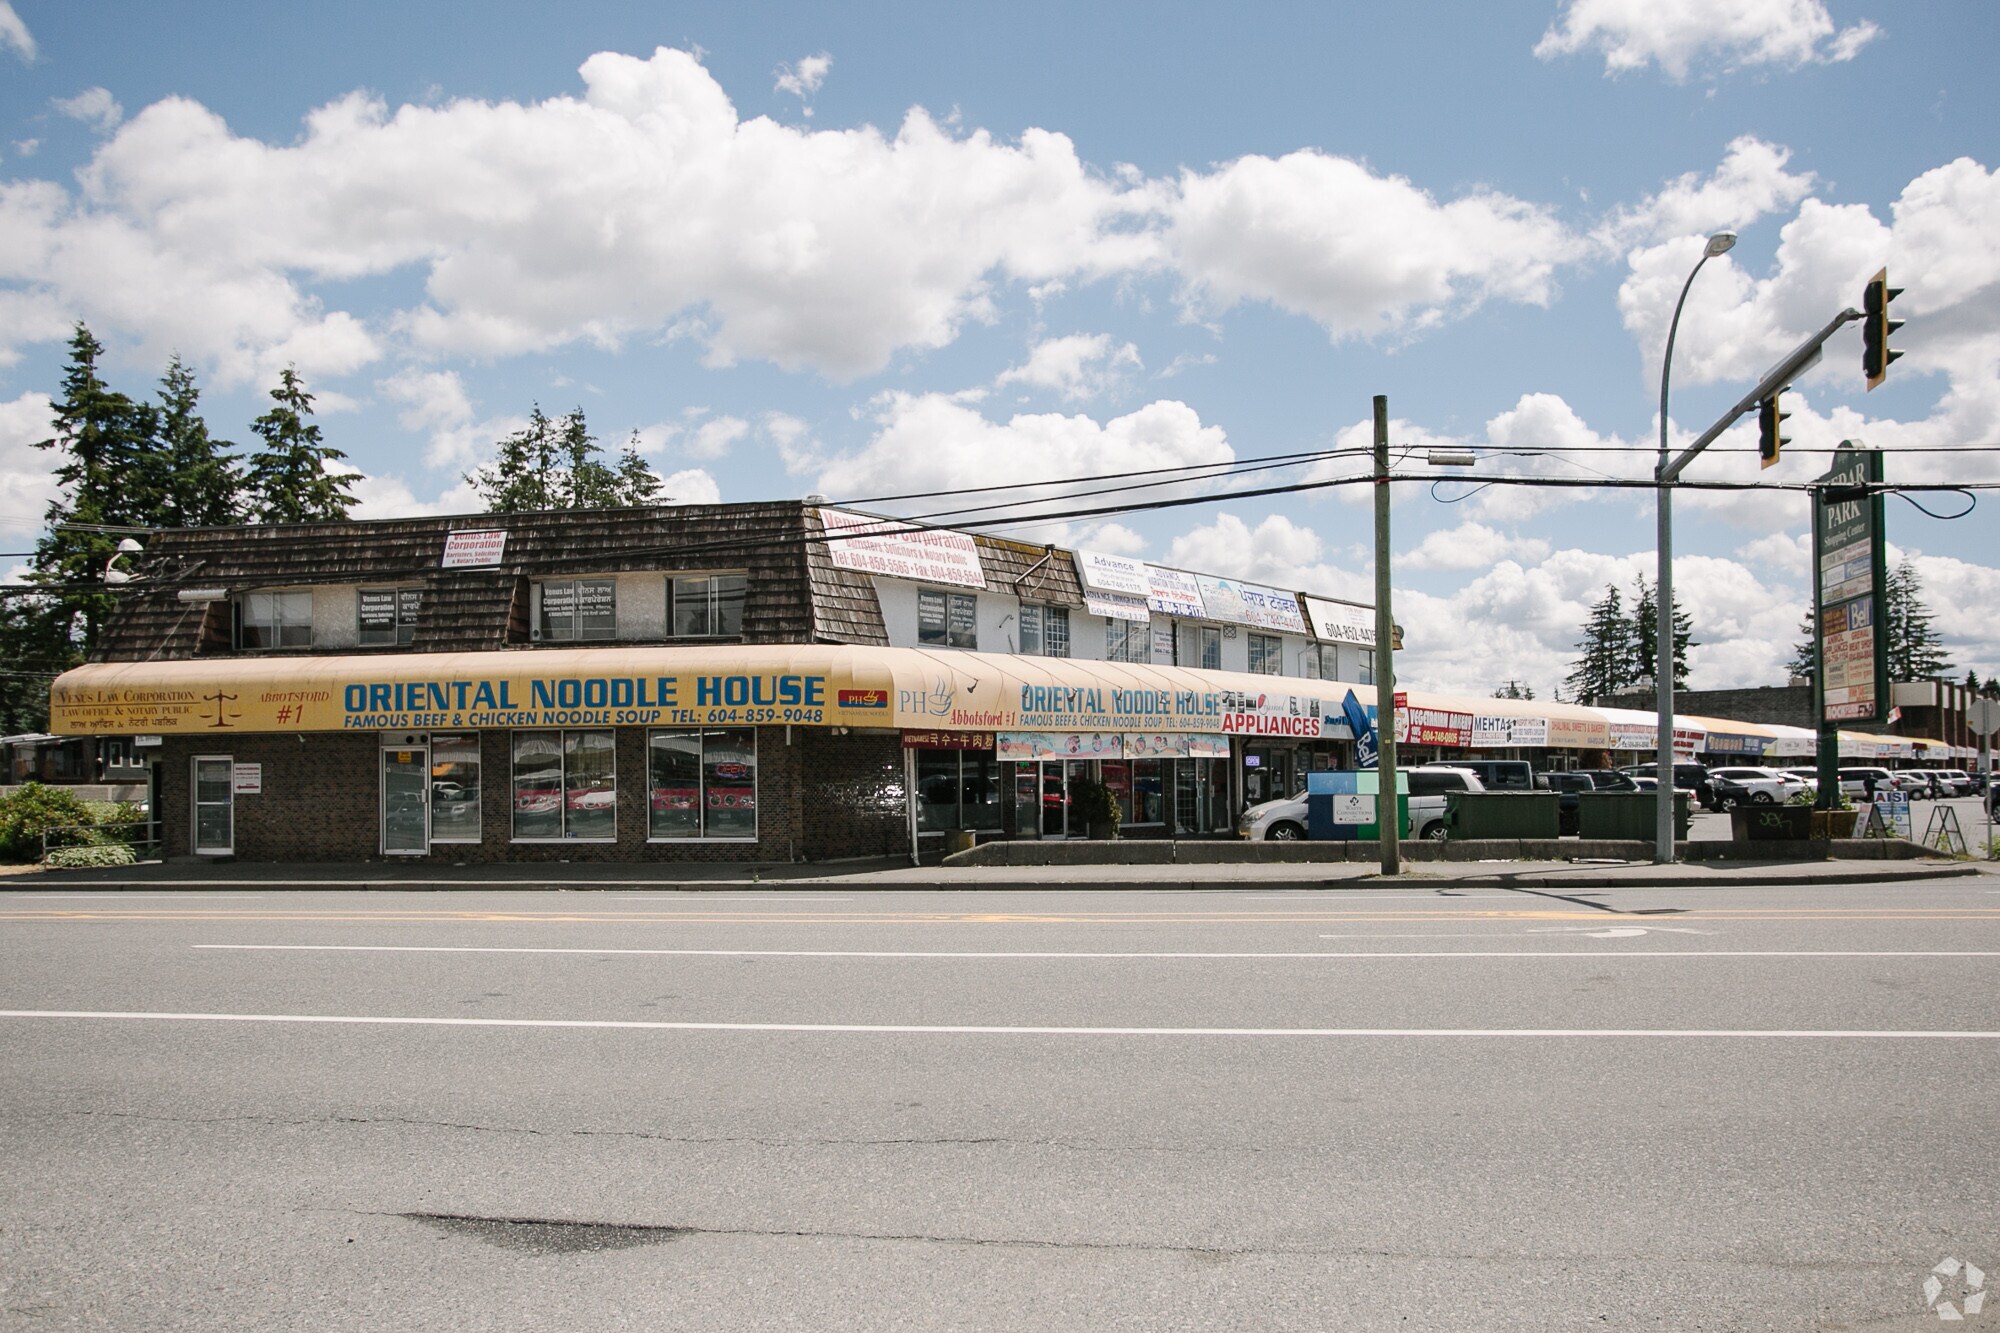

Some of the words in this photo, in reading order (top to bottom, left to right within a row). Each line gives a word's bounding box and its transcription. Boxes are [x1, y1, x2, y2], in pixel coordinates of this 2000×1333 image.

[1828, 499, 1861, 529] PARK
[1825, 529, 1847, 548] Shopping
[1847, 523, 1866, 538] Center
[448, 540, 503, 551] Corporation
[925, 550, 947, 564] Notary
[947, 553, 968, 566] Public
[1094, 555, 1134, 571] Advance
[834, 550, 850, 566] Tel:
[850, 552, 910, 575] 604-859-5565
[914, 562, 930, 577] Fax:
[931, 565, 983, 585] 604-859-5544
[362, 595, 381, 603] Venus
[381, 594, 392, 602] Law
[1086, 590, 1111, 602] ADVANCE
[361, 604, 395, 613] Corporation
[1091, 606, 1149, 622] 604-746-1175
[1851, 600, 1870, 629] Bell
[1245, 609, 1305, 631] 604-744-4400
[123, 689, 195, 702] CORPORATION
[260, 691, 330, 703] ABBOTSFORD
[344, 680, 519, 713] ORIENTAL
[531, 677, 678, 709] NOODLE
[697, 675, 825, 707] HOUSE
[1021, 685, 1105, 714] ORIENTAL
[1112, 689, 1171, 715] NOODLE
[1176, 691, 1220, 716] HOUSE
[62, 708, 79, 717] LAW
[82, 707, 111, 717] OFFICE
[114, 706, 124, 717] &
[127, 706, 158, 716] NOTARY
[162, 705, 193, 715] PUBLIC
[276, 704, 304, 724] #1
[344, 714, 408, 728] FAMOUS
[413, 713, 447, 727] BEEF
[452, 712, 463, 726] &
[468, 711, 537, 726] CHICKEN
[543, 709, 611, 725] NOODLE
[616, 709, 661, 724] SOUP
[671, 709, 701, 723] TEL:
[708, 708, 823, 723] 604-859-9048
[949, 709, 1003, 726] Abbotsford
[1019, 714, 1053, 726] FAMOUS
[1080, 715, 1111, 727] CHICKEN
[1113, 716, 1141, 728] NOODLE
[1144, 716, 1162, 728] SOUP
[1166, 717, 1178, 728] TEL:
[1179, 717, 1220, 729] 604-859-9048
[1222, 713, 1320, 736] APPLIANCES
[1474, 717, 1506, 731] MEHTA
[904, 735, 931, 743] VIETNAMESE
[1357, 730, 1380, 767] Bell
[1876, 792, 1907, 803] AISI
